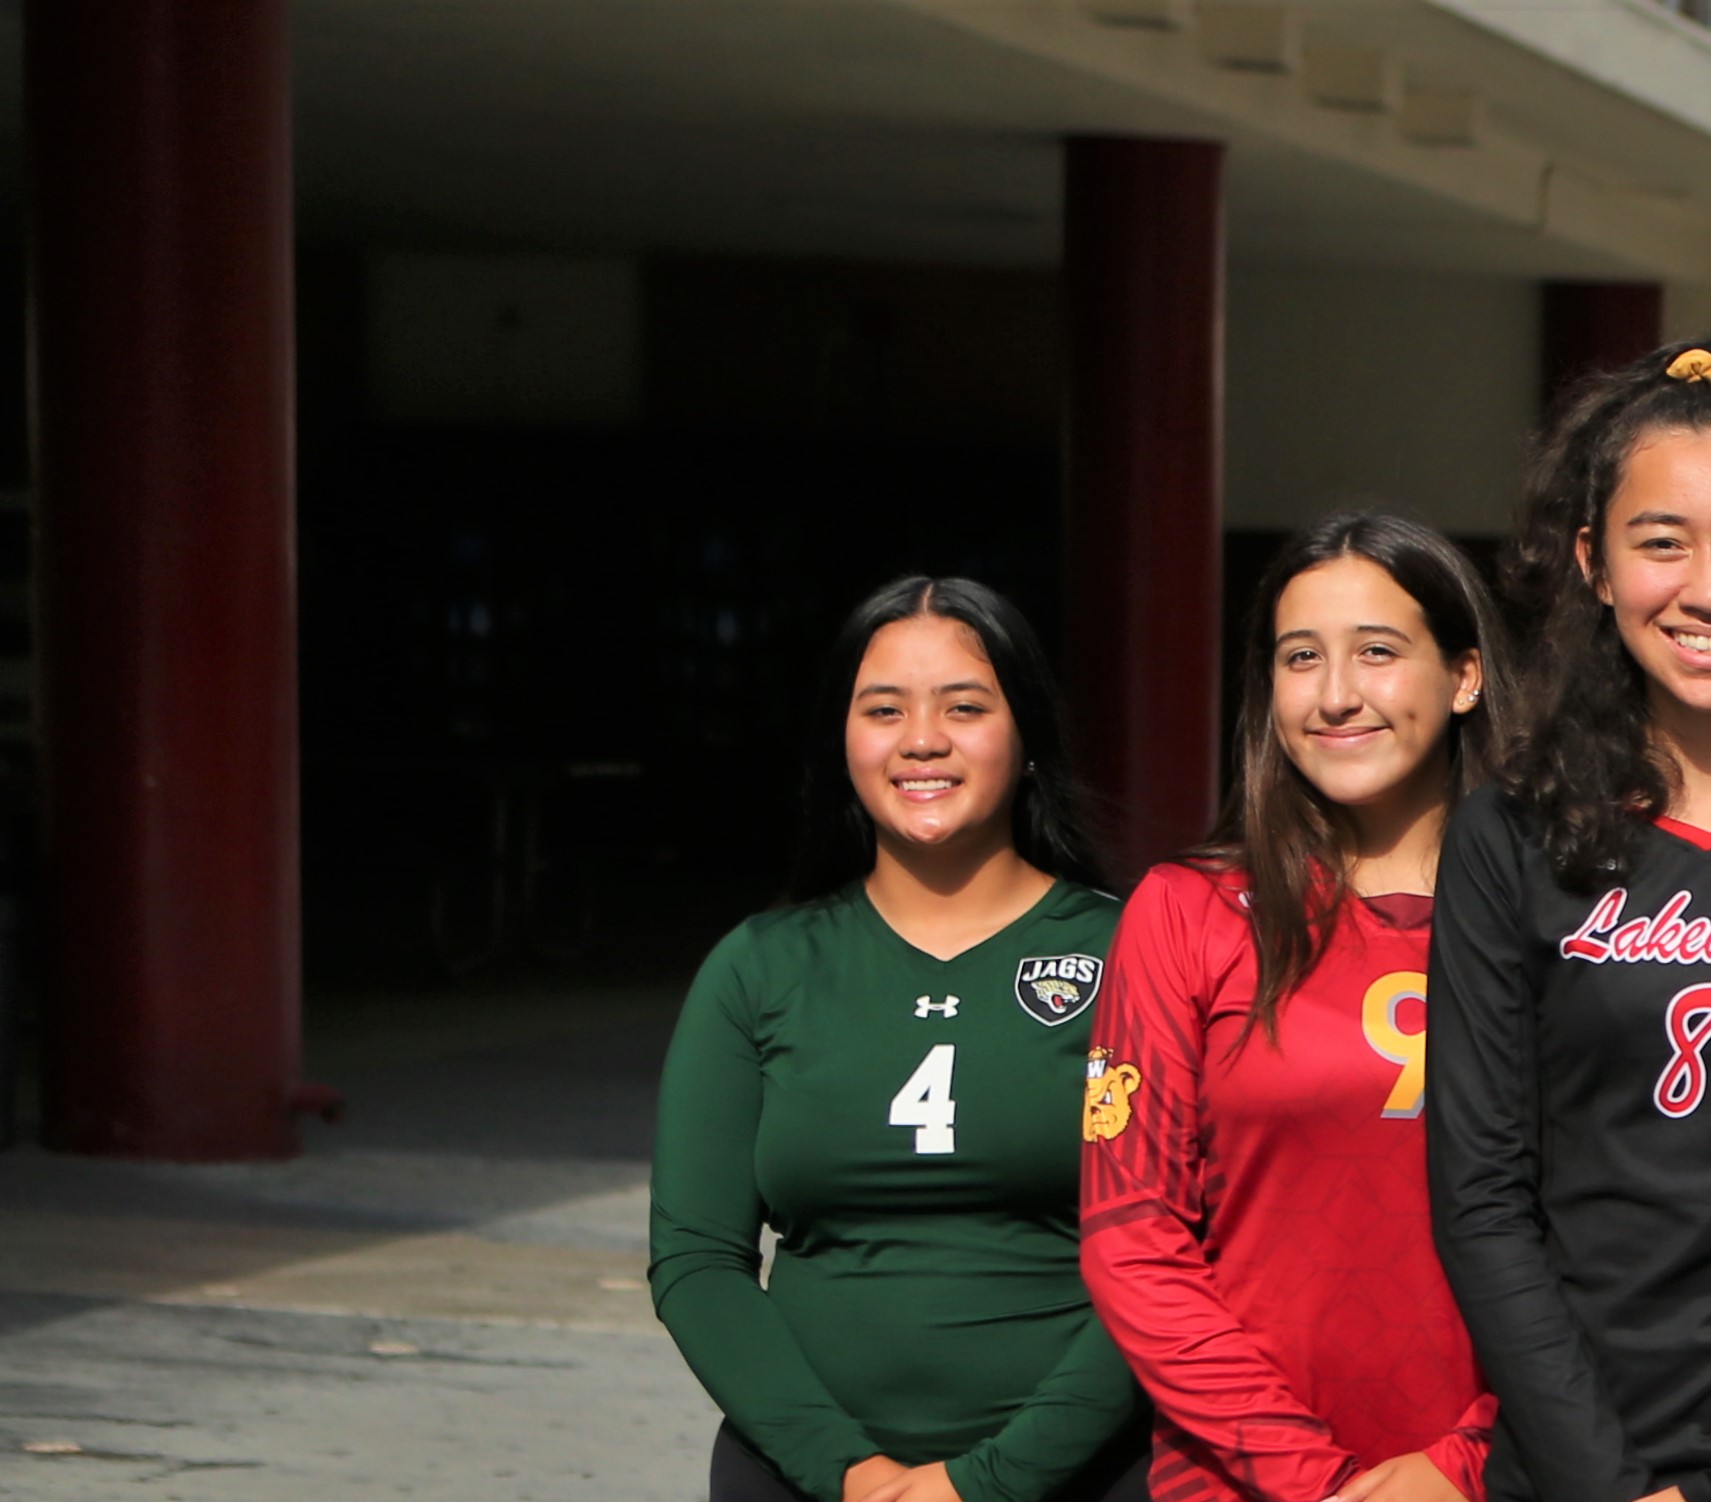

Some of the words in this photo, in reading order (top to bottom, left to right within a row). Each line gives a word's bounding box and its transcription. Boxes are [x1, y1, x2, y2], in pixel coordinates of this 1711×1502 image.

[1021, 957, 1096, 983] JAGS
[888, 1043, 957, 1155] 4
[1361, 971, 1428, 1119] 9
